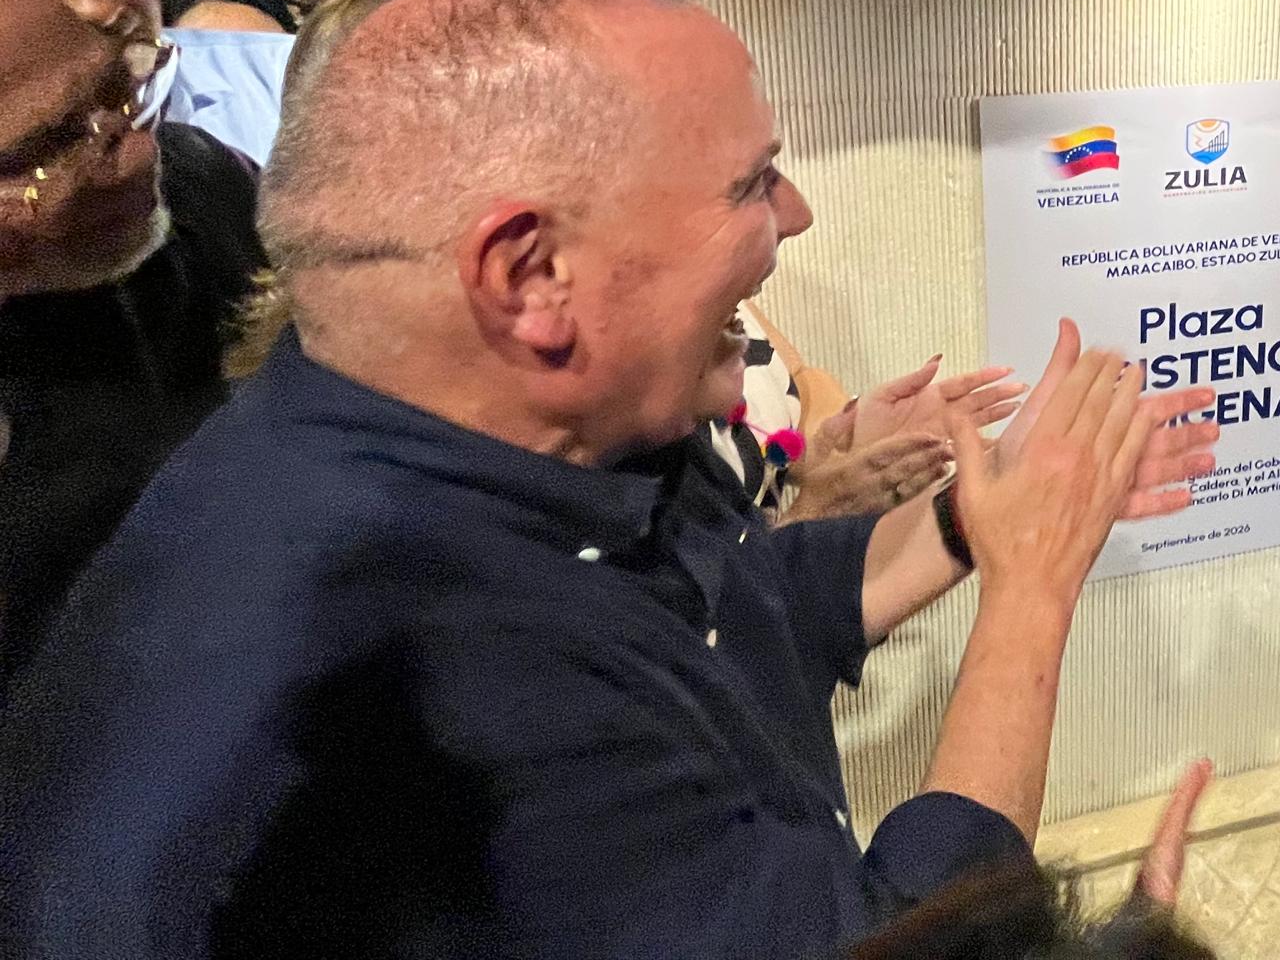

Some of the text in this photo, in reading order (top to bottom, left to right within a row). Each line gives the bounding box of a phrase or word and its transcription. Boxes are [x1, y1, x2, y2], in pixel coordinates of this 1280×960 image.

[1164, 166, 1247, 190] ZULIA
[1037, 192, 1120, 208] VENEZUELA
[1062, 250, 1139, 267] REPÚBLICA
[1143, 238, 1238, 258] BOLIVARIANA
[1242, 236, 1258, 248] DE
[1201, 252, 1256, 268] ESTADO
[1140, 303, 1263, 344] Plaza
[1233, 460, 1252, 474] del
[1244, 476, 1252, 487] y
[1254, 471, 1265, 481] el
[1189, 491, 1229, 506] ncarlo
[1232, 488, 1244, 499] Di
[1141, 534, 1206, 552] Septiembre
[1207, 530, 1221, 540] de
